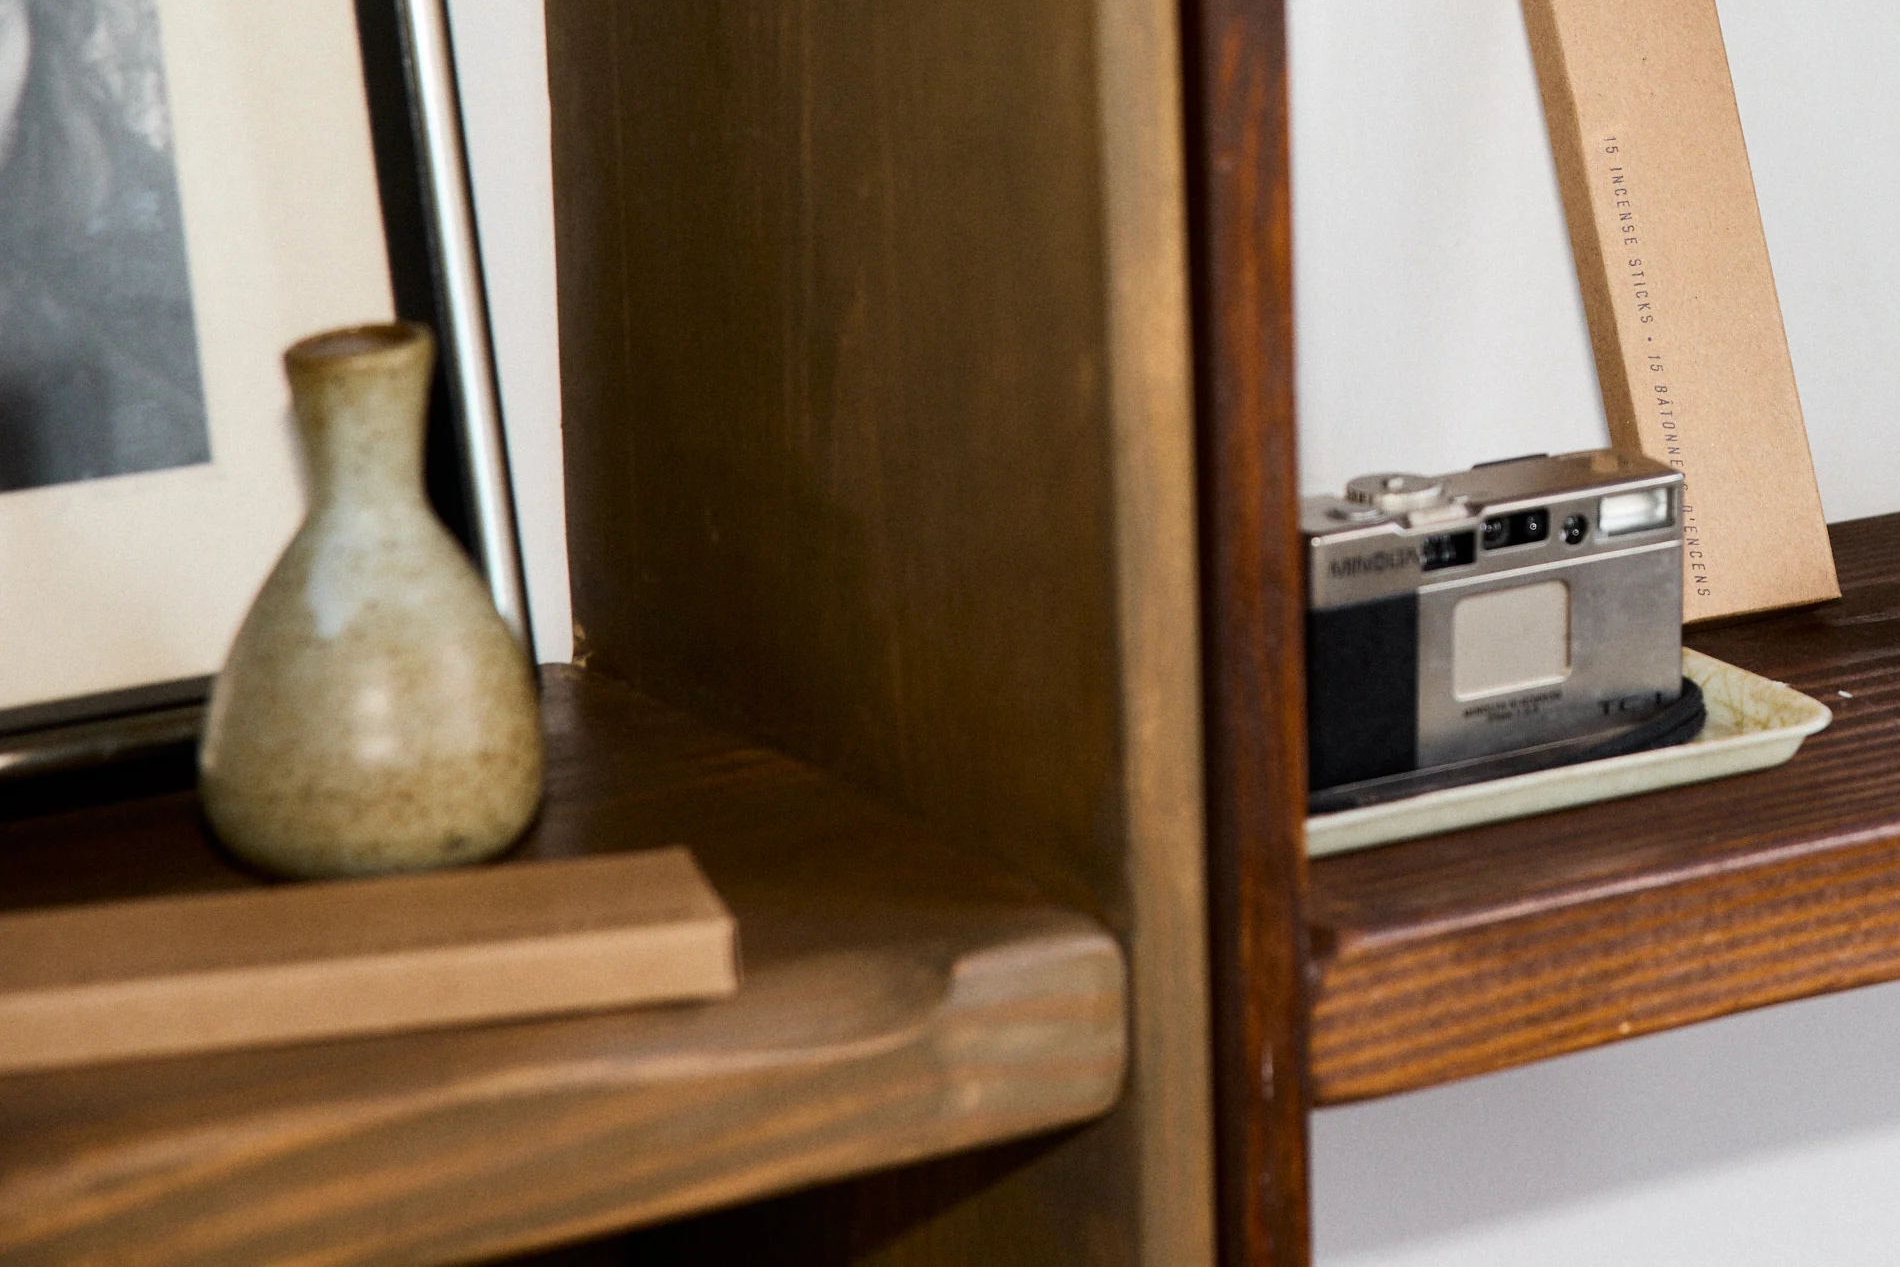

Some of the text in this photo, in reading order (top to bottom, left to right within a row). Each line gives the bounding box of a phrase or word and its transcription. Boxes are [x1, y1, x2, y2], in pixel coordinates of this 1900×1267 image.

[1603, 135, 1620, 154] 15
[1609, 167, 1639, 246] INCENSE
[1628, 258, 1654, 324] STICKS
[1647, 354, 1664, 372] 15
[1653, 385, 1689, 491] BÂTONNE
